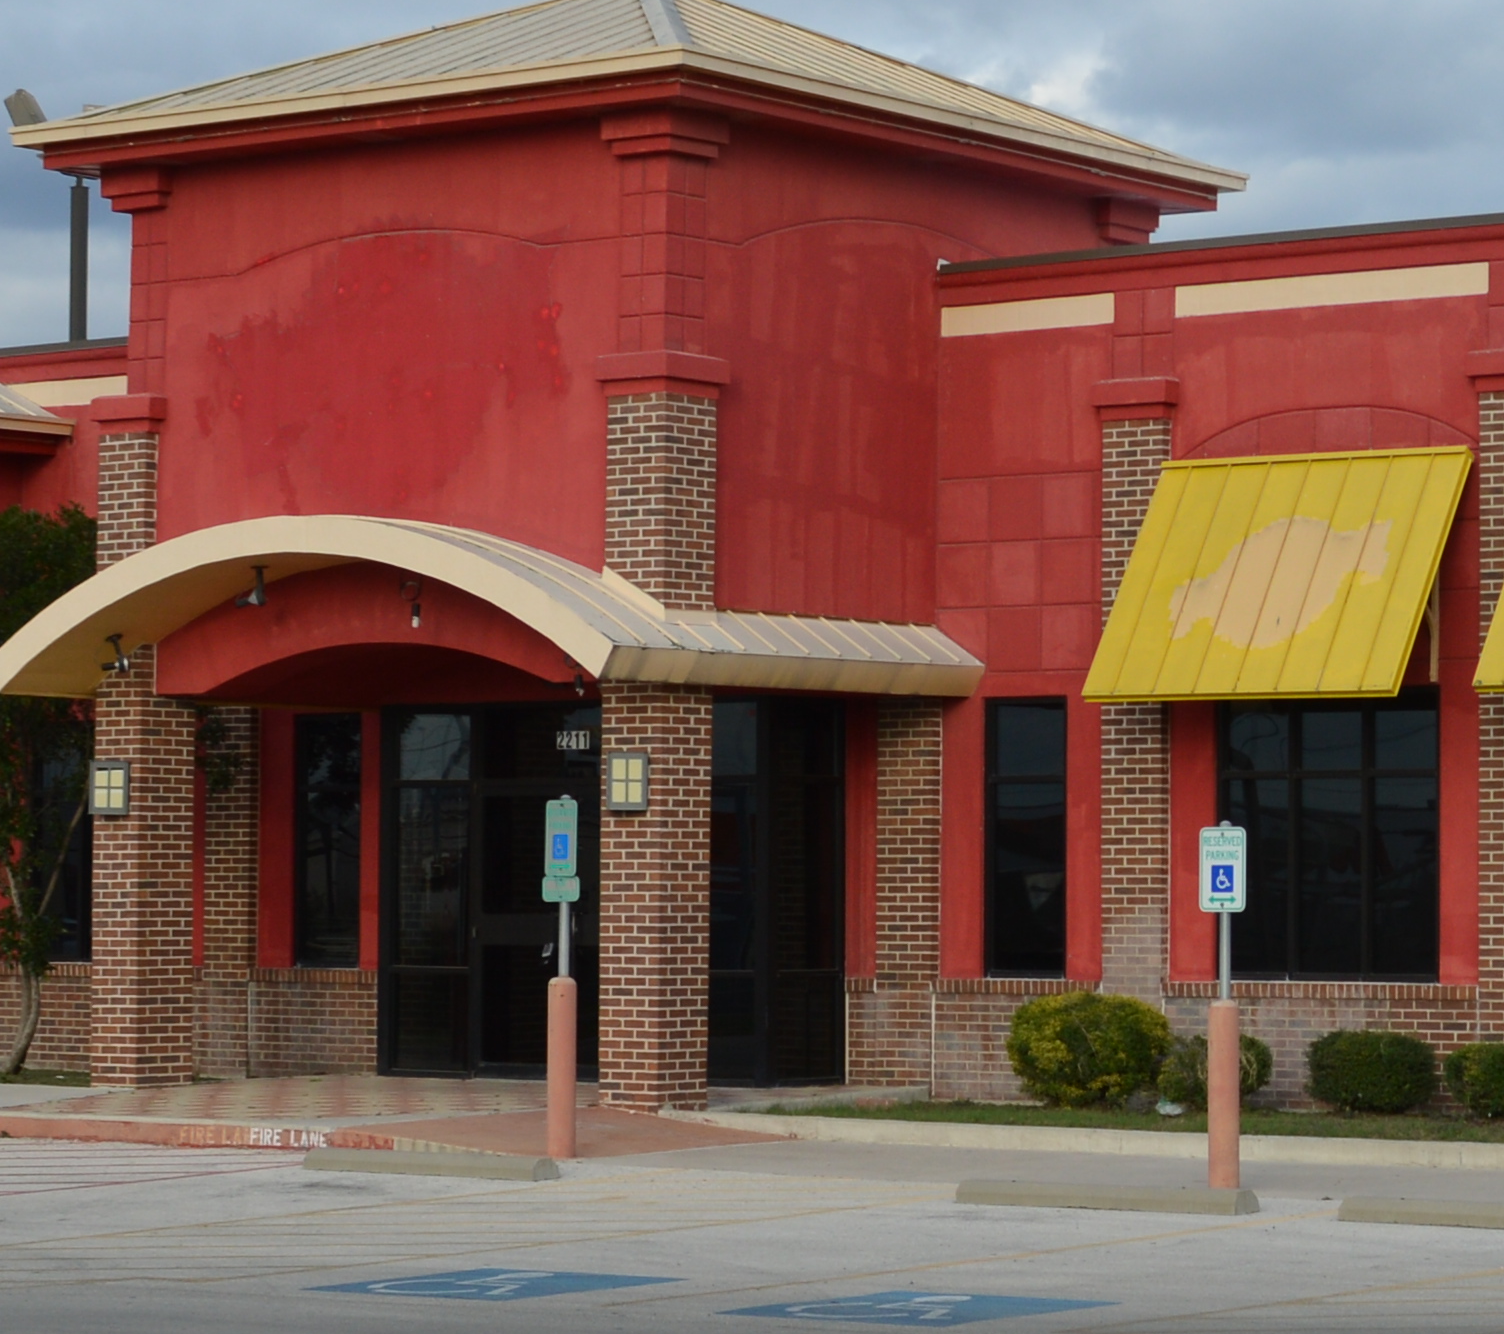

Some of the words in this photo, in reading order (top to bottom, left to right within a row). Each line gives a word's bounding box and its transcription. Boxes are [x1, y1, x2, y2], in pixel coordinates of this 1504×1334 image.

[557, 731, 589, 749] 2211
[1203, 836, 1242, 847] RESERVED
[1205, 850, 1239, 861] PARKING
[250, 1127, 282, 1146] FIRE
[290, 1130, 327, 1148] LANE
